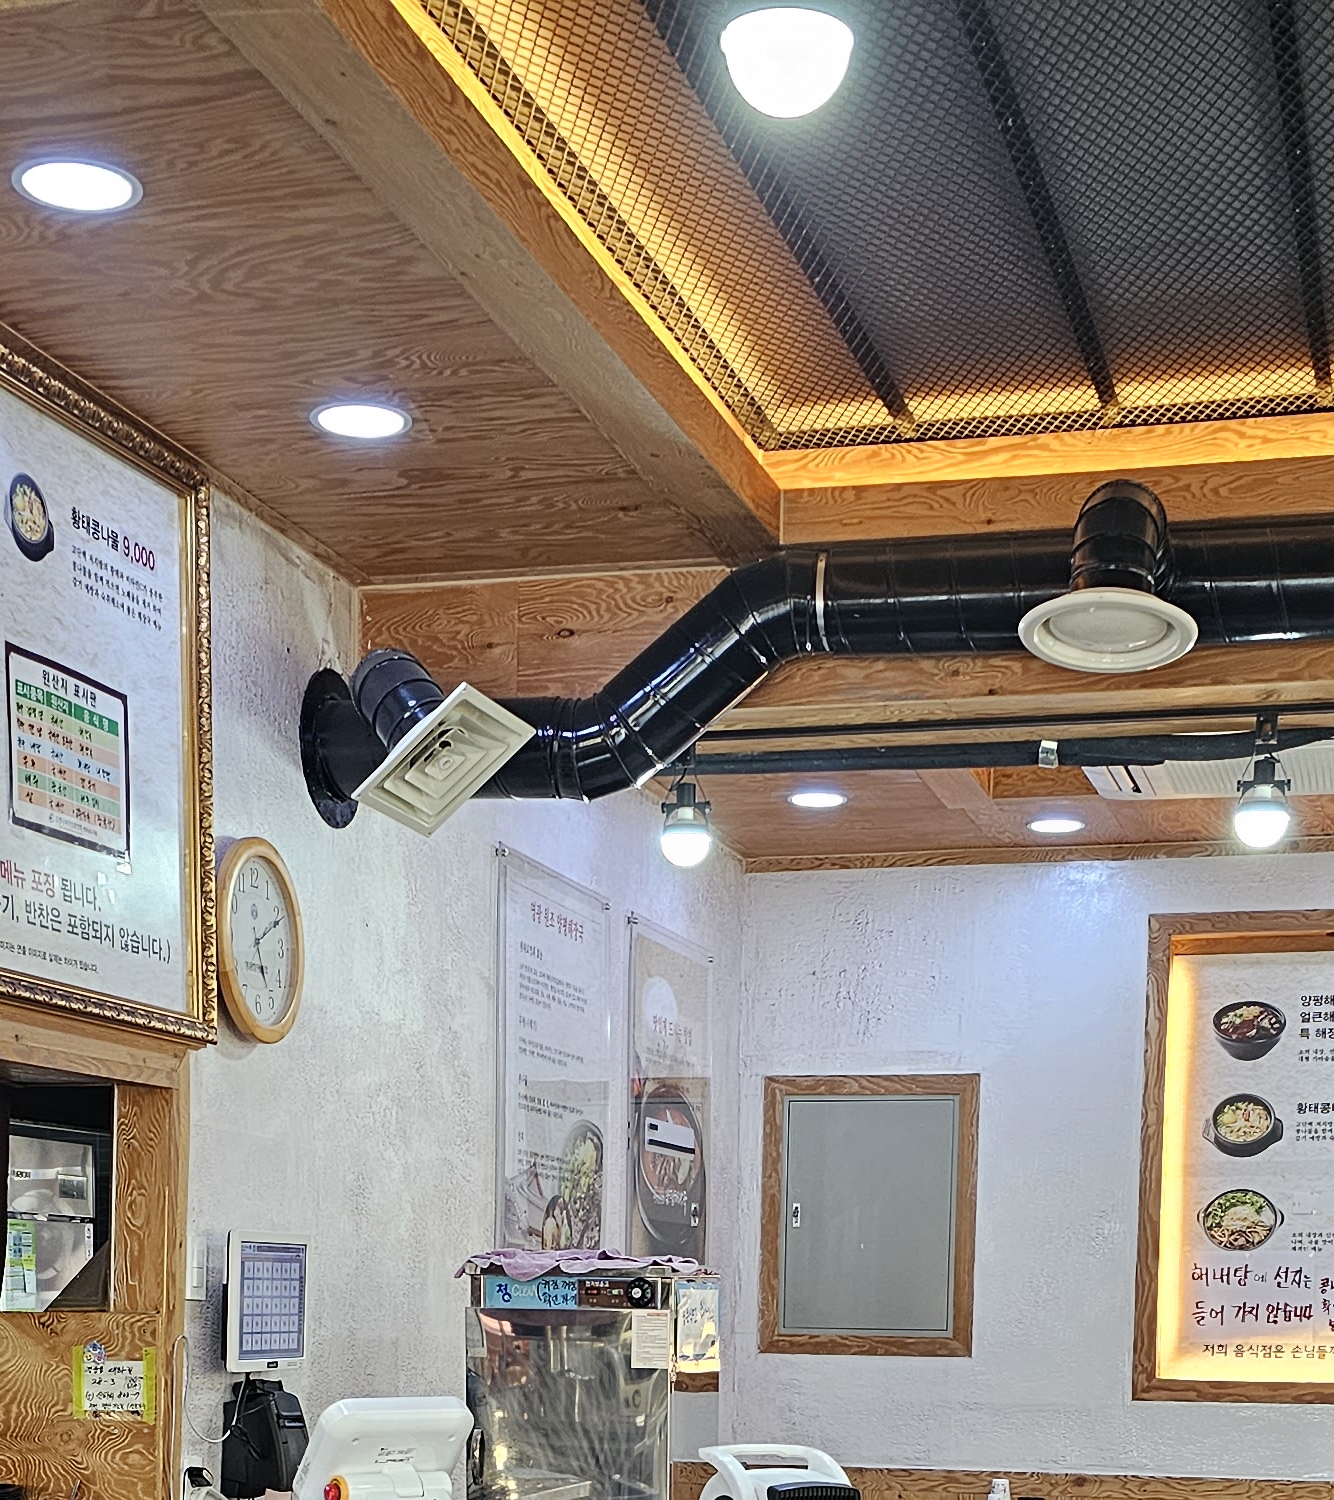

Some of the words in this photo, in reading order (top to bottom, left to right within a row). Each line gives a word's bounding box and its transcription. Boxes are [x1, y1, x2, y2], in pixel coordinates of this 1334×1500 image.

[71, 507, 119, 552] 황태콩나물
[123, 536, 155, 571] 9,000
[42, 669, 68, 695] 원산지
[73, 683, 97, 708] 표시판
[0, 860, 26, 890] 메뉴
[61, 878, 101, 912] 됩니다.
[250, 867, 259, 889] 12
[25, 899, 62, 933] 반찬은
[67, 913, 114, 948] 포함되지
[119, 927, 171, 964] 않습니다.)
[278, 938, 284, 958] 3
[255, 994, 261, 1014] 6
[1299, 1027, 1310, 1039] 특
[1274, 1265, 1312, 1289] 선지는
[1192, 1301, 1224, 1326] 들어
[1231, 1302, 1260, 1323] 가지
[1202, 1343, 1227, 1358] 저희
[1233, 1344, 1285, 1359] 음식점은
